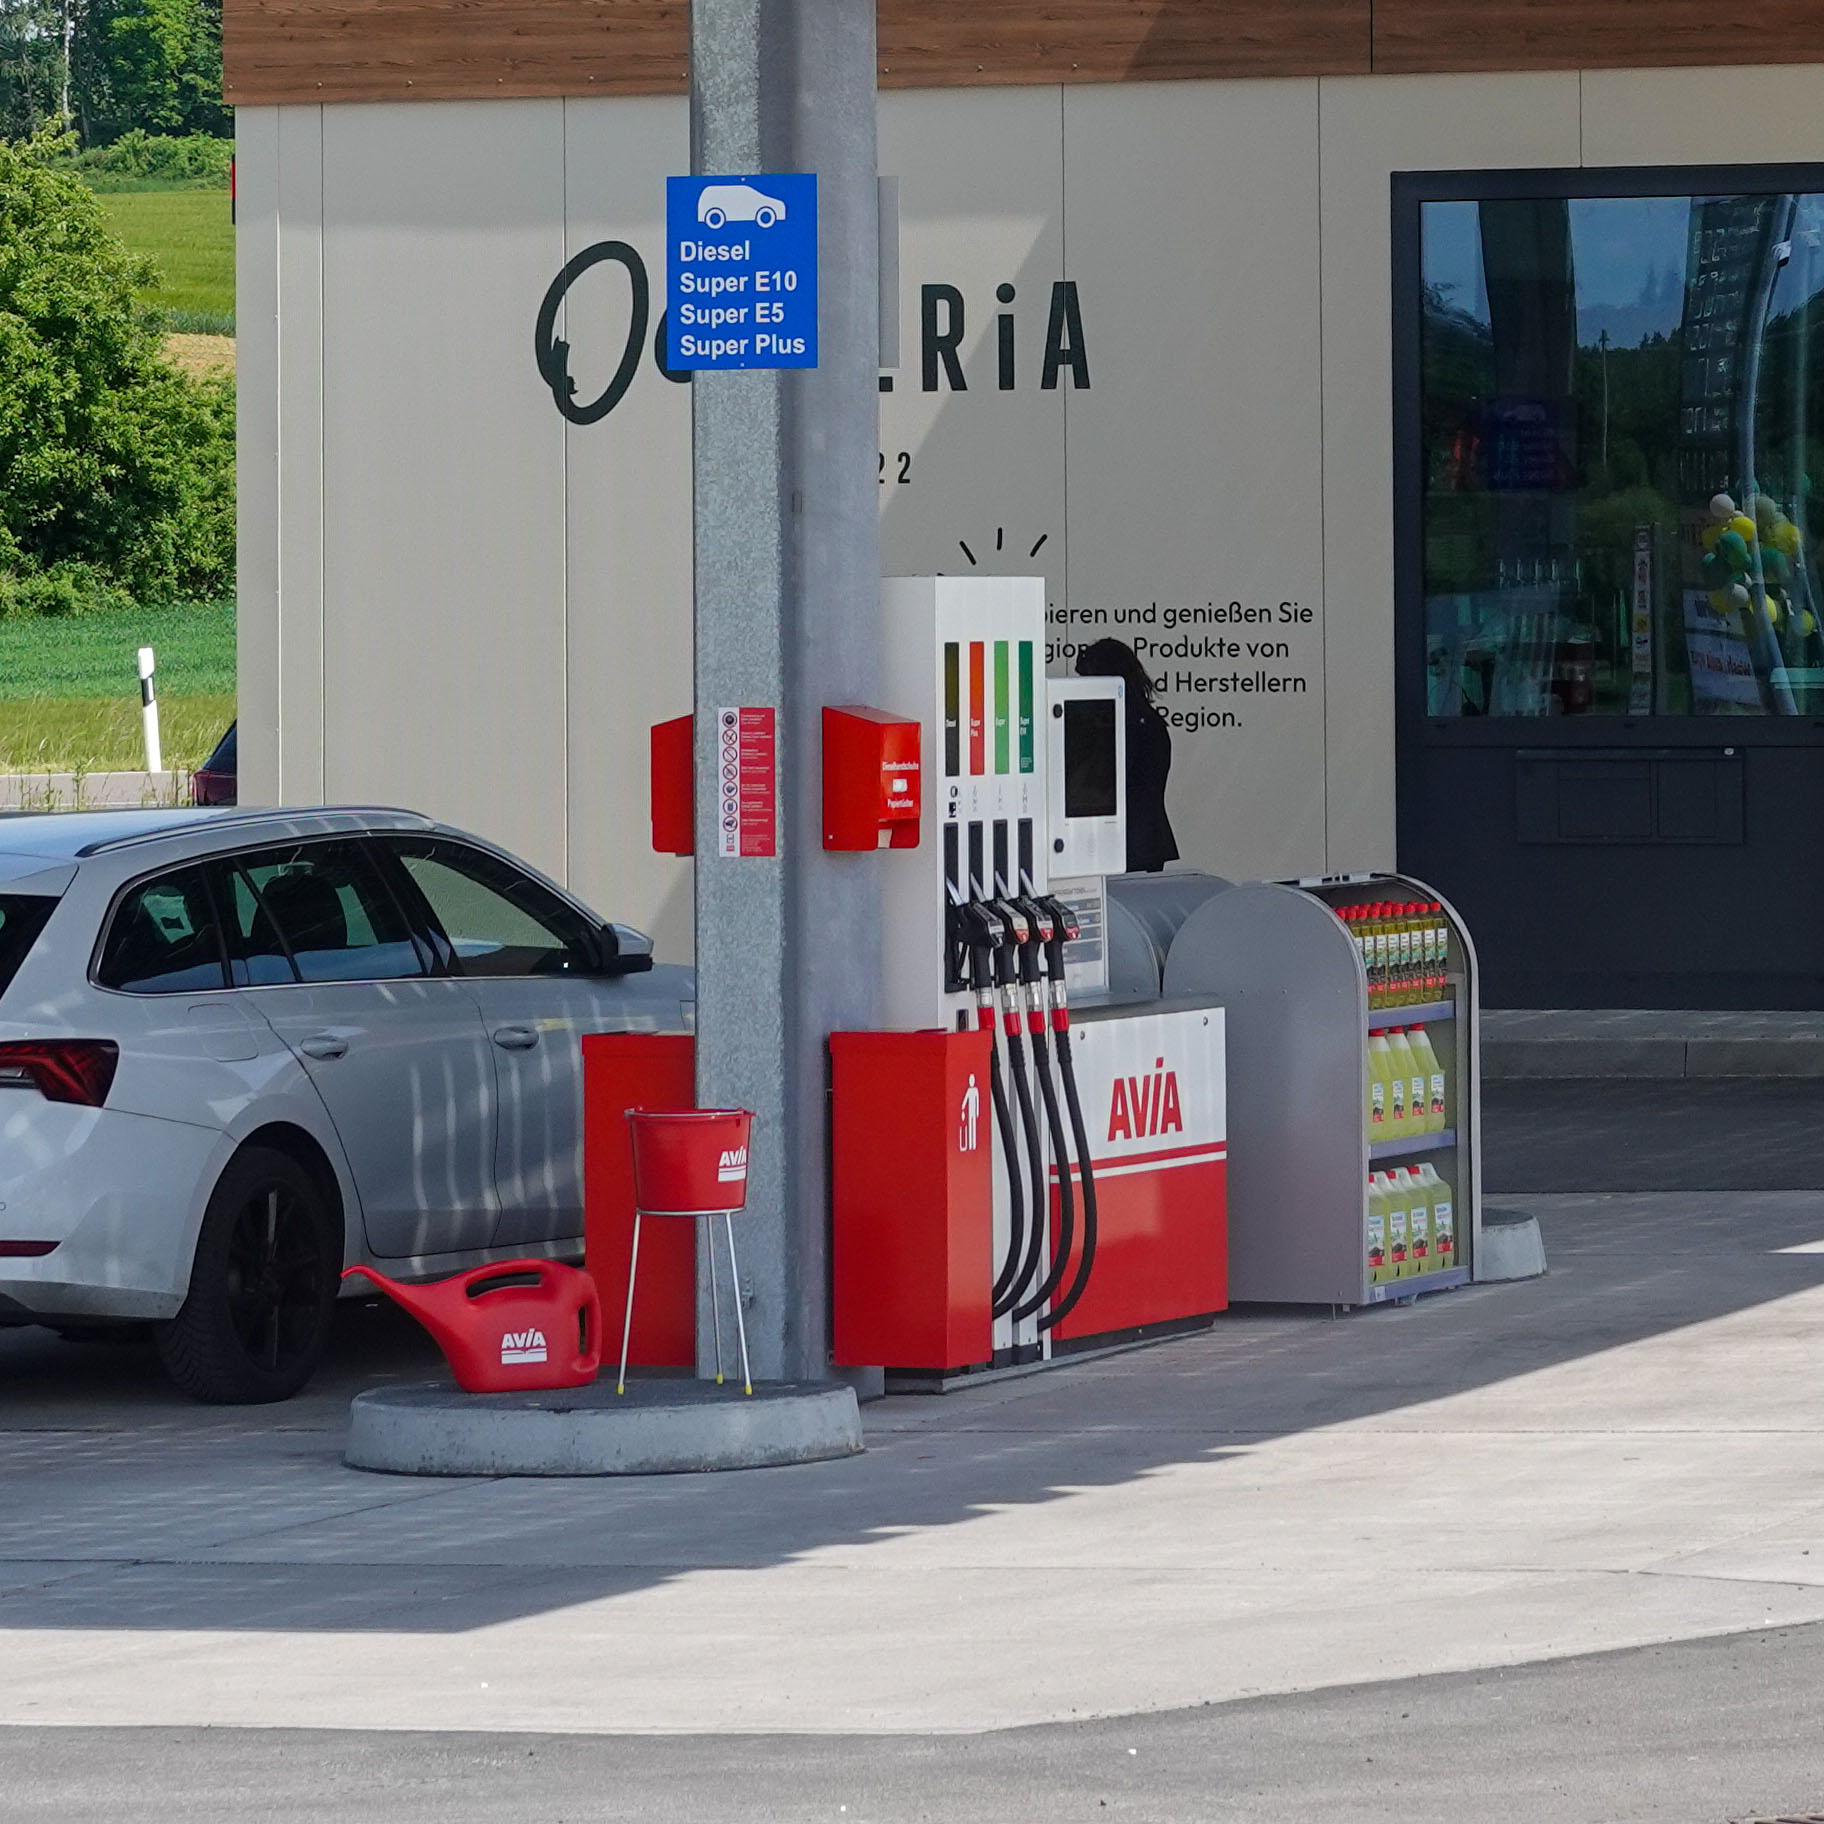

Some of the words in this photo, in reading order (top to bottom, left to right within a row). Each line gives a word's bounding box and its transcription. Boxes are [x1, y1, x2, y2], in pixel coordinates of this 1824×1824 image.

[679, 239, 751, 262] Diesel
[679, 271, 749, 298] Super
[755, 270, 798, 292] E10
[679, 303, 749, 329] Super
[755, 302, 785, 324] E5
[679, 334, 749, 360] Super
[755, 333, 806, 355] Plus
[1114, 602, 1156, 624] und
[1163, 601, 1272, 629] genießen
[1278, 601, 1314, 624] Sie
[1133, 634, 1241, 659] Produkte
[1246, 642, 1290, 658] von
[1175, 671, 1307, 693] Herstellern
